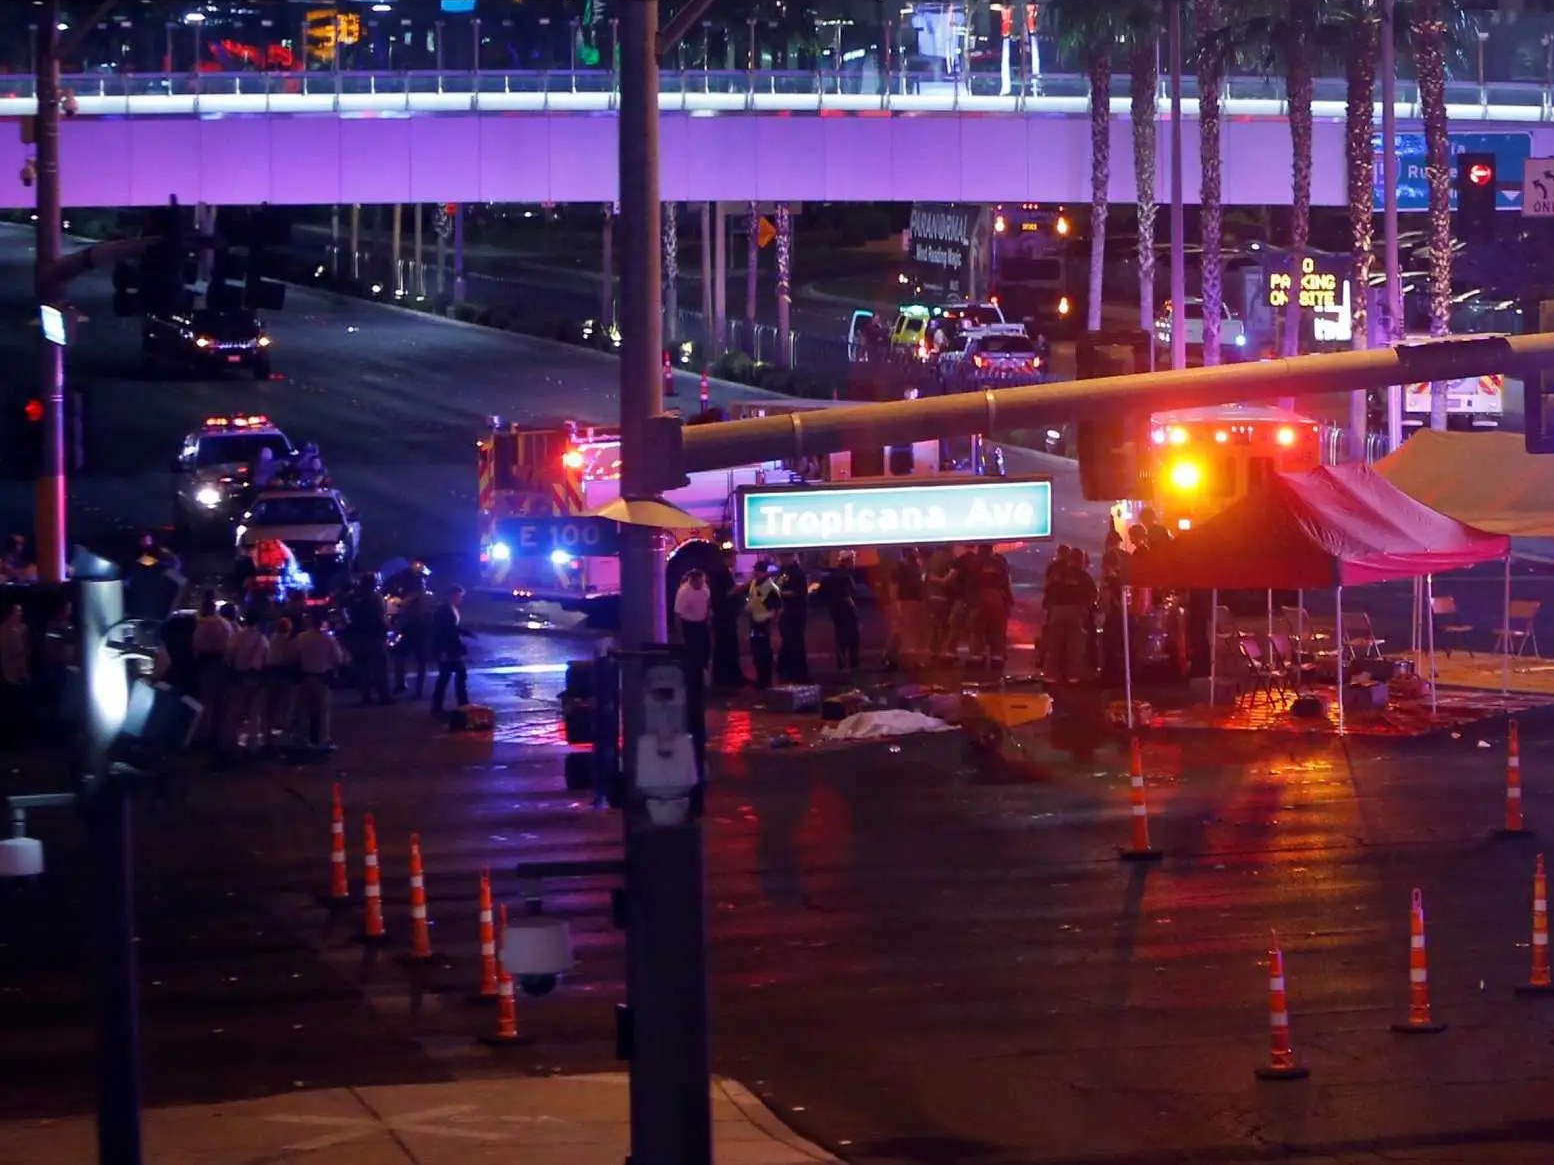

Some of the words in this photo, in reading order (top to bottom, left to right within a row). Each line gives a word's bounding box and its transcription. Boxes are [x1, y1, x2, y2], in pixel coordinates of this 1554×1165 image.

[1270, 273, 1336, 290] PAKING
[759, 501, 948, 539] Tropicana
[964, 497, 1035, 528] Ave
